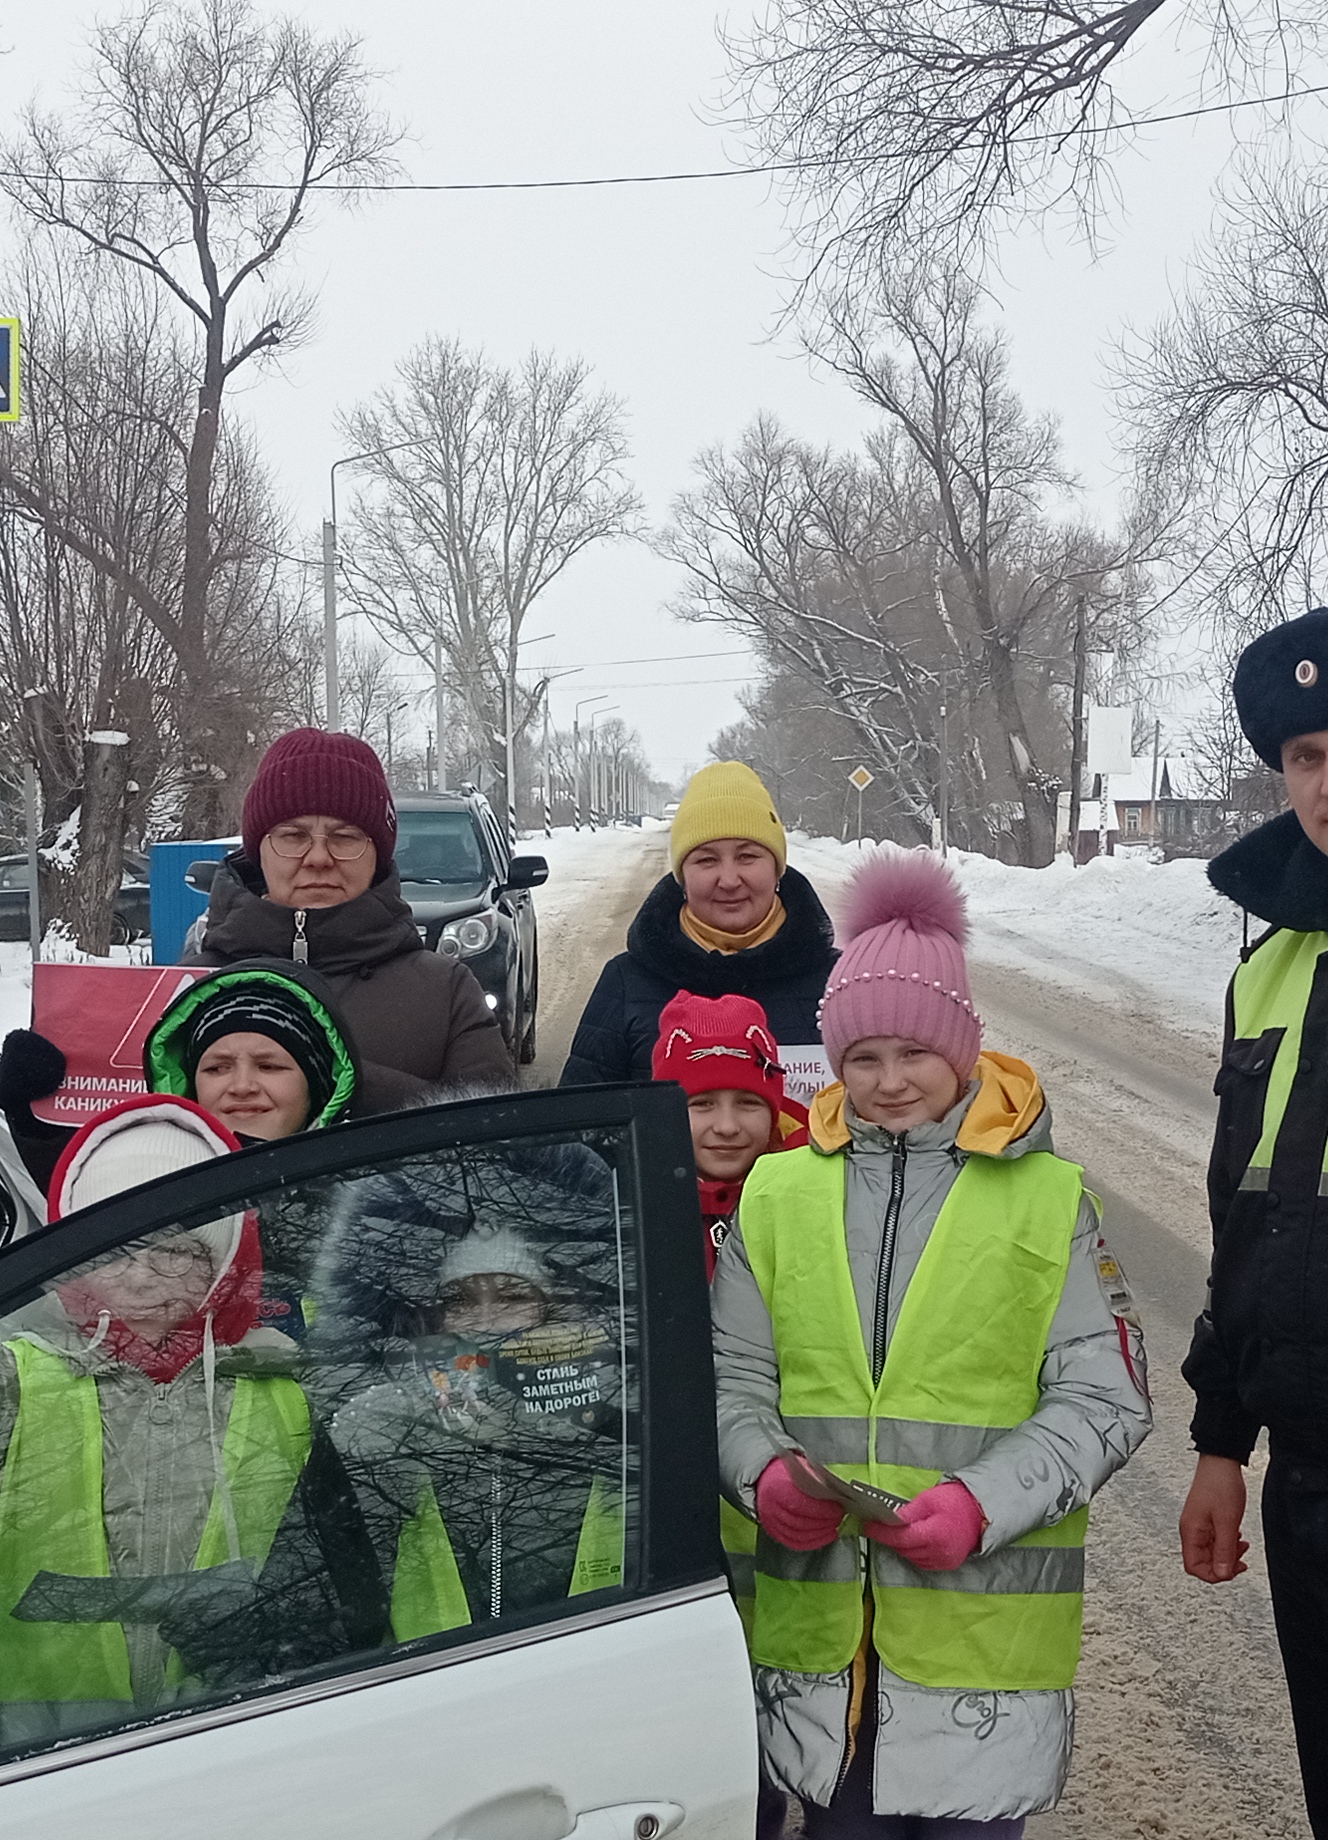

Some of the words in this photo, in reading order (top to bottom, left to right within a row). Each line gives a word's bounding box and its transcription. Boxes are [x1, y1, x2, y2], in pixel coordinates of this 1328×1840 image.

[784, 1062, 825, 1075] АНИЕ,
[785, 1080, 825, 1094] УЛЫ!
[537, 1365, 579, 1381] СТАНЬ
[522, 1375, 598, 1397] ЗАМЕТНЫМ
[525, 1400, 544, 1414] НА
[545, 1390, 600, 1414] ДОРОГЕ!
